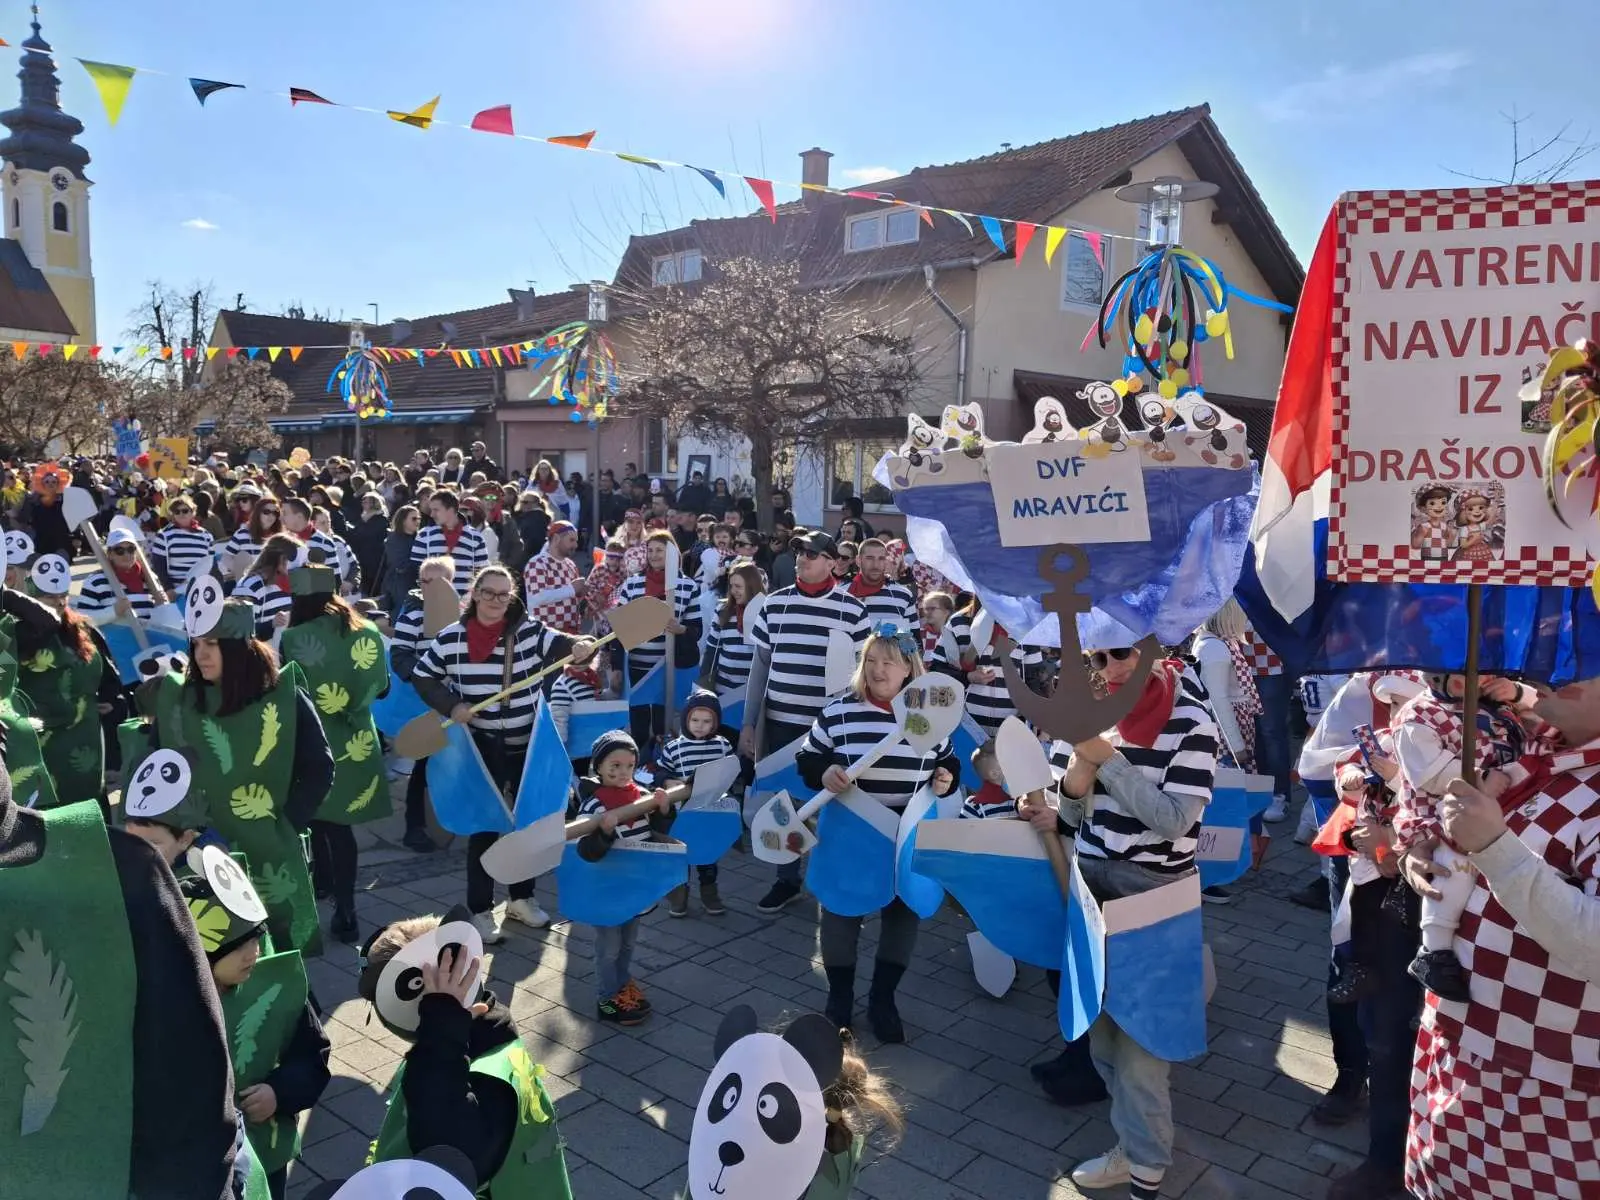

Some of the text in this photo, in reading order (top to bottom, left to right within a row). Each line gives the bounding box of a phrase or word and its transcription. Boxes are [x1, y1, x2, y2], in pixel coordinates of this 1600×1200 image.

[1369, 242, 1600, 290] VATRENI
[1363, 301, 1600, 361] NAVIJAČI
[1458, 374, 1502, 414] IZ
[1036, 456, 1086, 480] DVF
[1347, 438, 1596, 481] DRAŠKOV
[1013, 486, 1129, 519] MRAVIĆI
